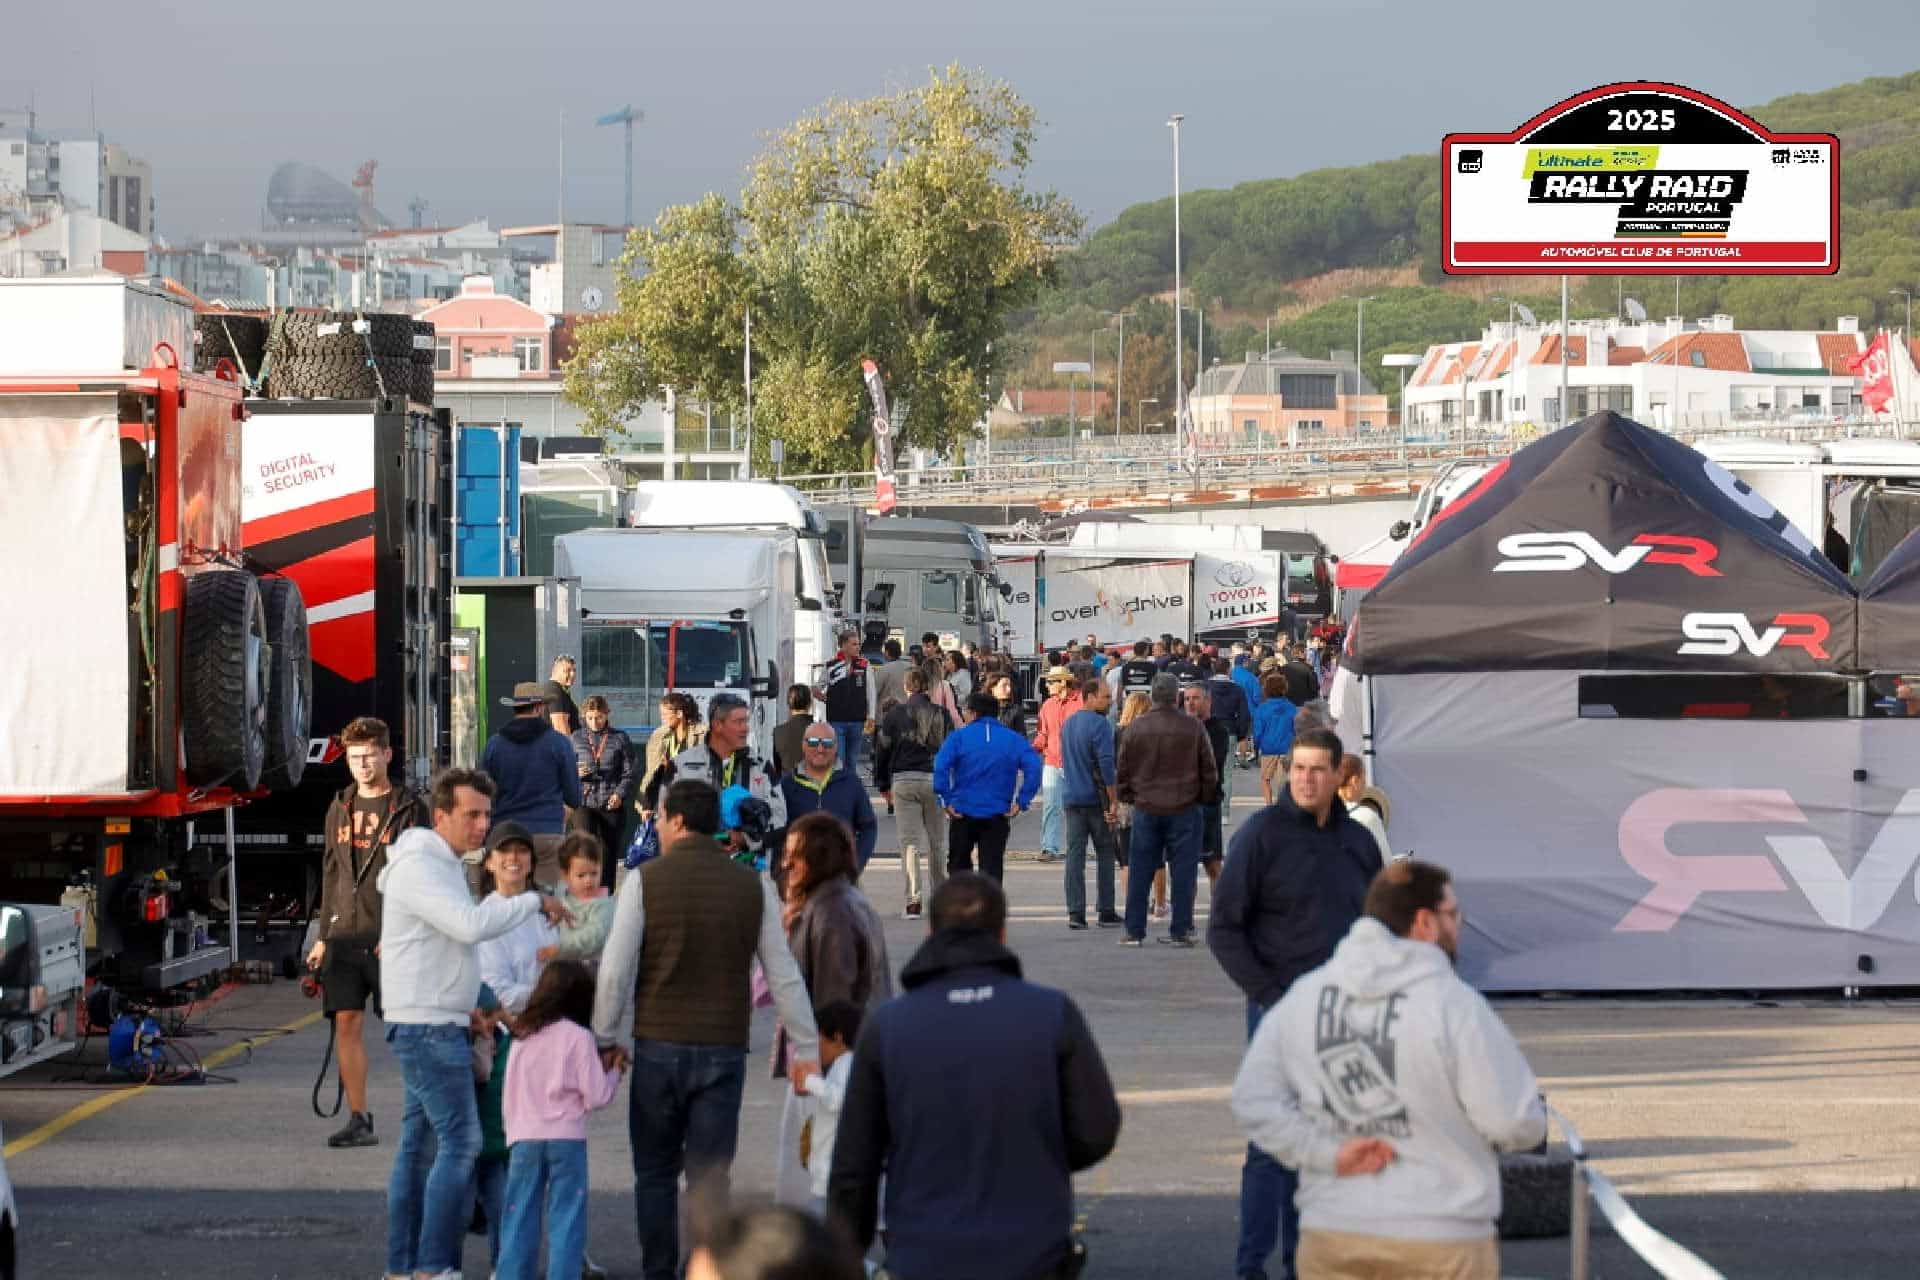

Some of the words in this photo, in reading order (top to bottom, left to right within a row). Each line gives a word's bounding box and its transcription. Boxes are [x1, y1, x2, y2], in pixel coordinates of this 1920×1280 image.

[260, 452, 319, 478] DIGITAL
[263, 461, 336, 494] SECURITY
[1492, 531, 1726, 577] SVR
[1051, 604, 1101, 622] over
[1125, 594, 1184, 612] drive
[1207, 586, 1267, 604] TOYOTA
[1209, 601, 1268, 621] HILUX
[1677, 612, 1831, 660] SVR
